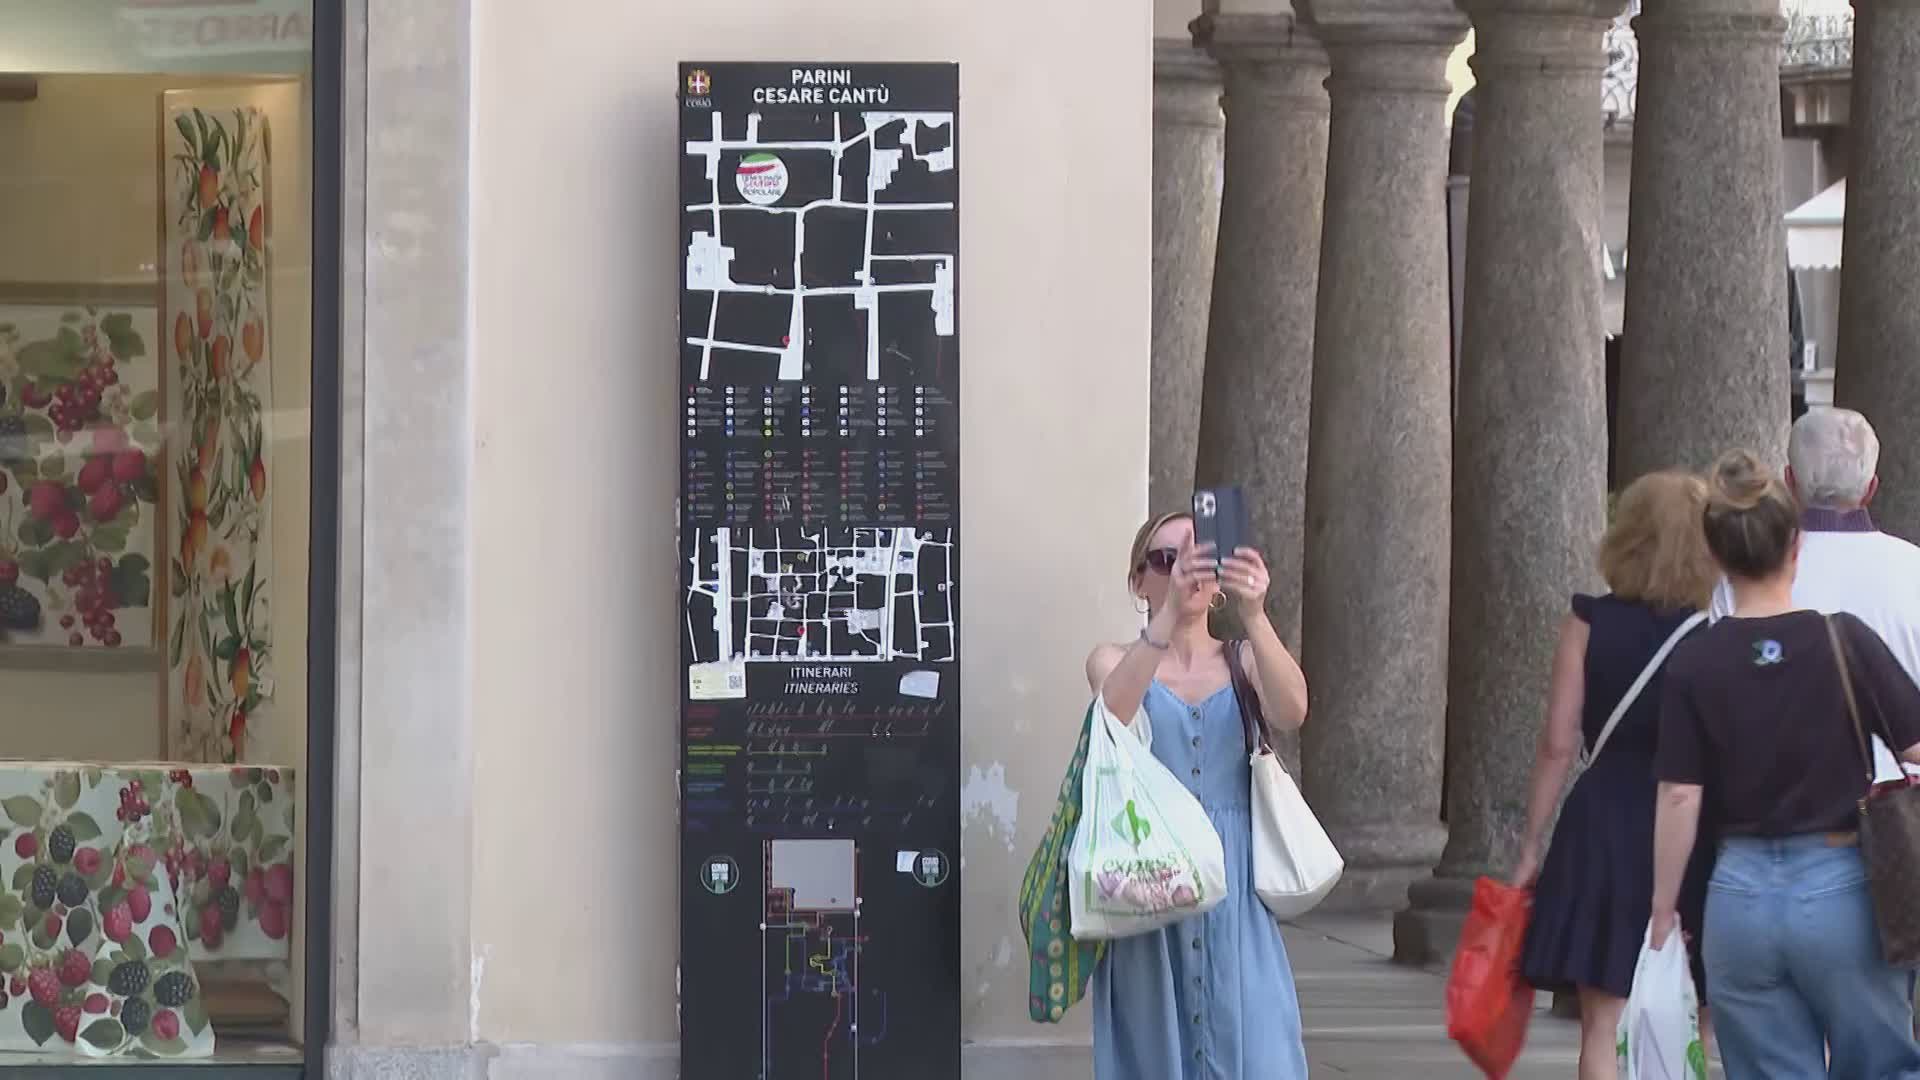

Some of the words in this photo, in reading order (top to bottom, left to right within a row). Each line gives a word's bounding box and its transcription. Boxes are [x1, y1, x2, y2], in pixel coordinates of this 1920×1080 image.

[791, 69, 851, 85] PARINI
[753, 87, 824, 104] CESARE
[829, 83, 889, 104] CANTÙ
[791, 667, 852, 679] ITINERARI
[784, 681, 859, 694] ITINERARIES
